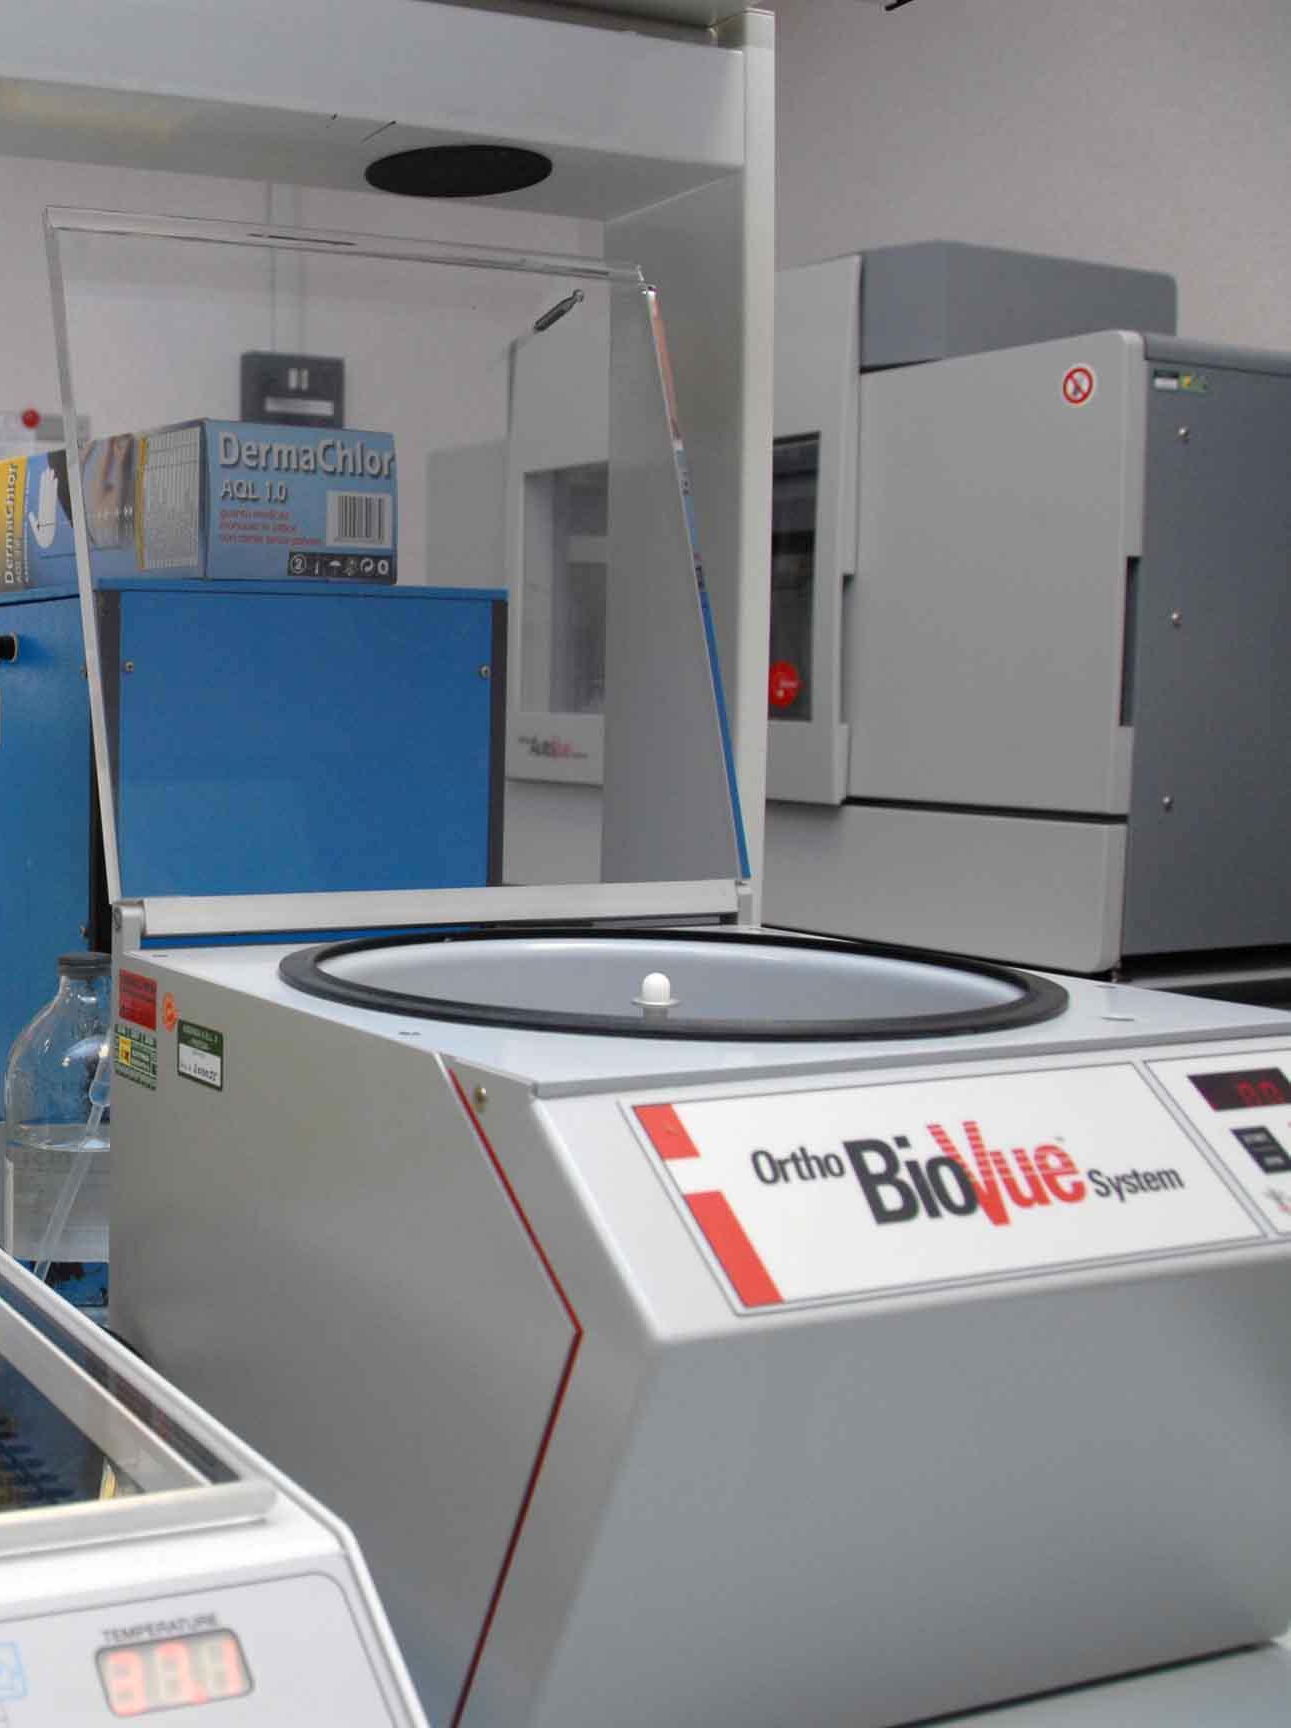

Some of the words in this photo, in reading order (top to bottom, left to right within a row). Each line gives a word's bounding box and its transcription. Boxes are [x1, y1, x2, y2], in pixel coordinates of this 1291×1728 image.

[219, 431, 396, 478] DermaChlor
[221, 479, 260, 502] AQL
[265, 480, 289, 504] 1.0
[5, 463, 18, 584] DermaChlor
[751, 1146, 845, 1185] Ortho
[843, 1120, 1087, 1227] BioVue
[1088, 1167, 1185, 1203] System
[101, 1613, 220, 1644] TEMPERATURE
